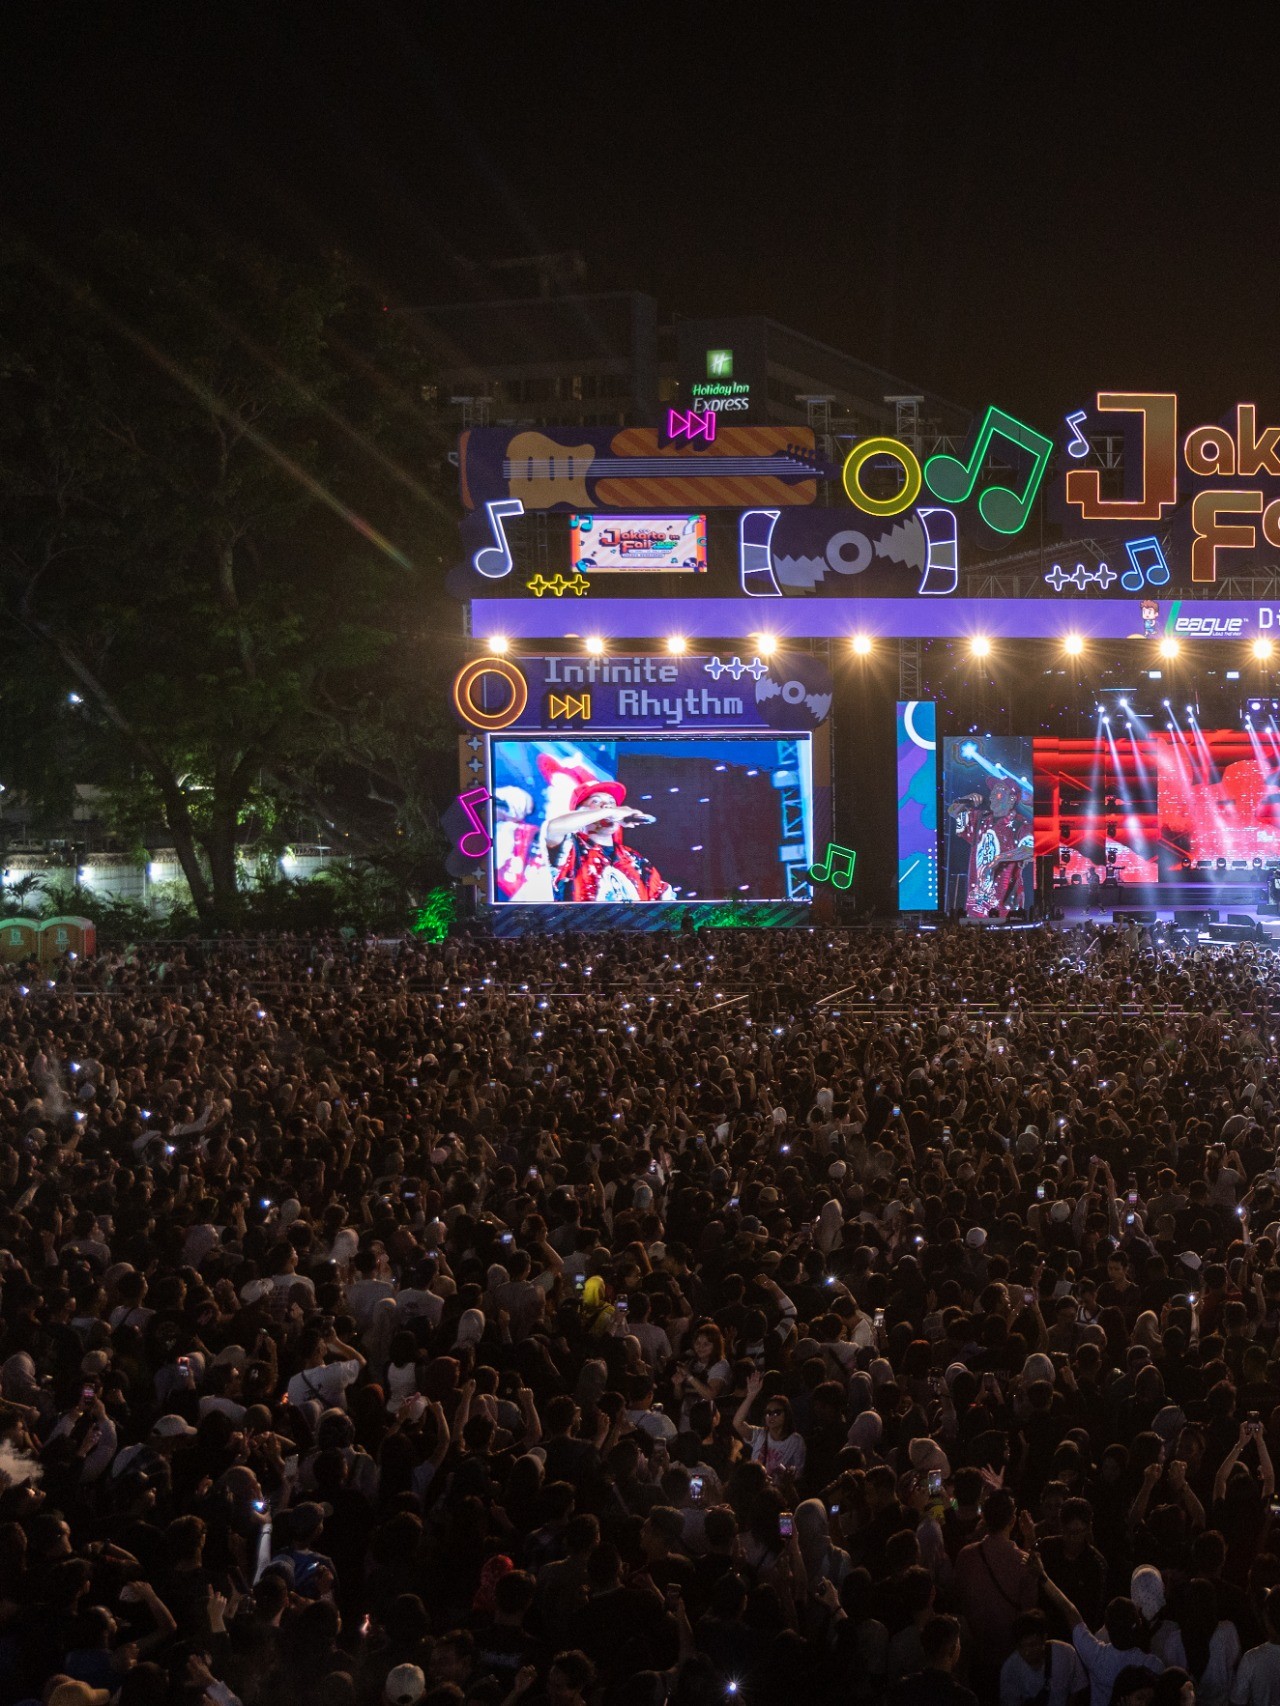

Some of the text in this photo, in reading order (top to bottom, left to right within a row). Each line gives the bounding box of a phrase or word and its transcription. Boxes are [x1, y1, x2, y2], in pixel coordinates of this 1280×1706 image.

[692, 381, 750, 396] Holiday Inn
[693, 397, 750, 414] Express
[545, 656, 679, 683] Infinite
[619, 688, 744, 725] Rhythm
